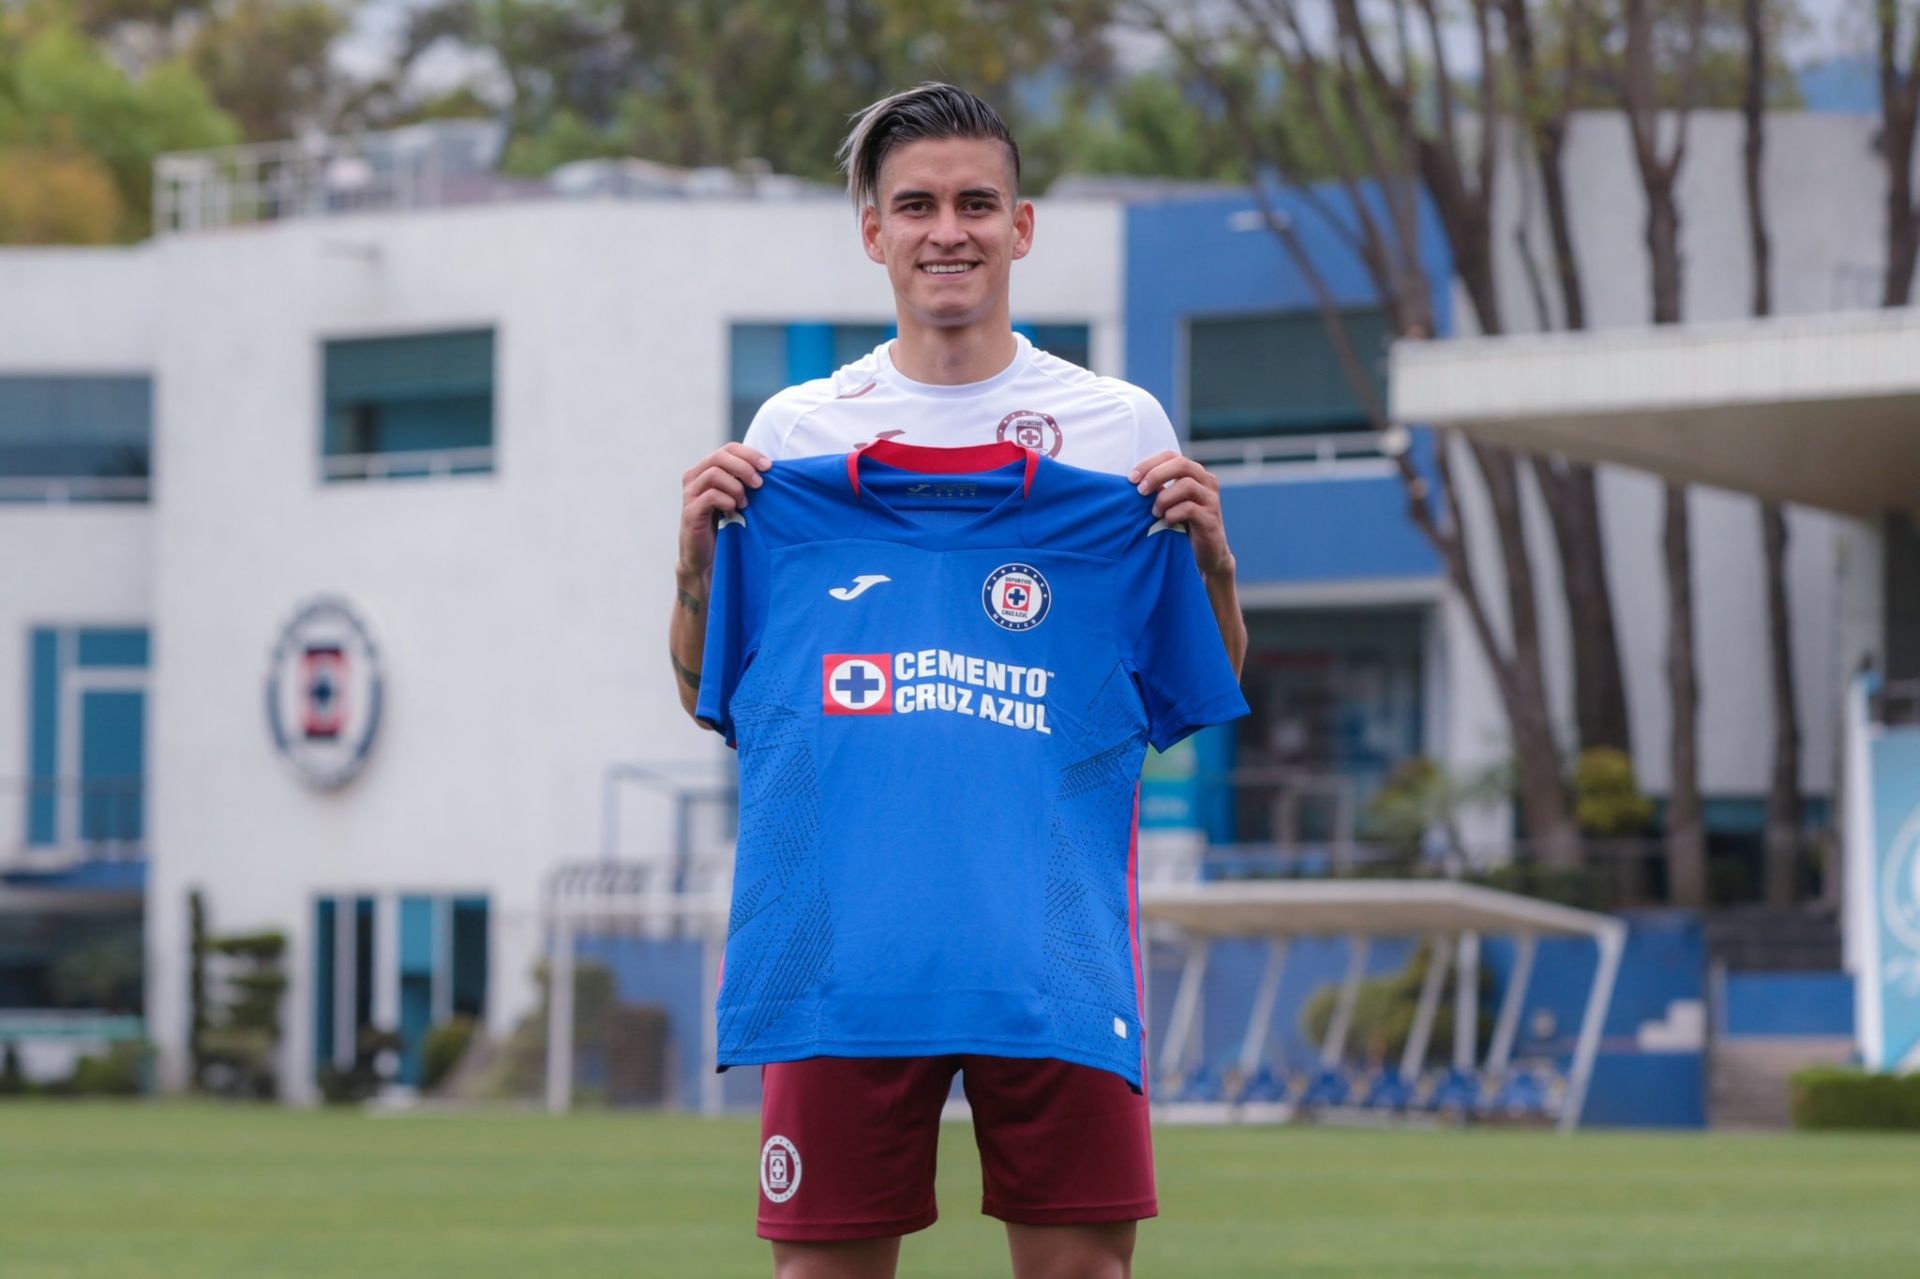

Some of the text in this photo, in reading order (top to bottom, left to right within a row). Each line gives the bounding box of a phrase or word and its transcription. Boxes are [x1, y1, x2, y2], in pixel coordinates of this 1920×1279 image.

[894, 648, 1048, 698] CEMENTO
[894, 682, 1052, 735] CRUZ AZUL
